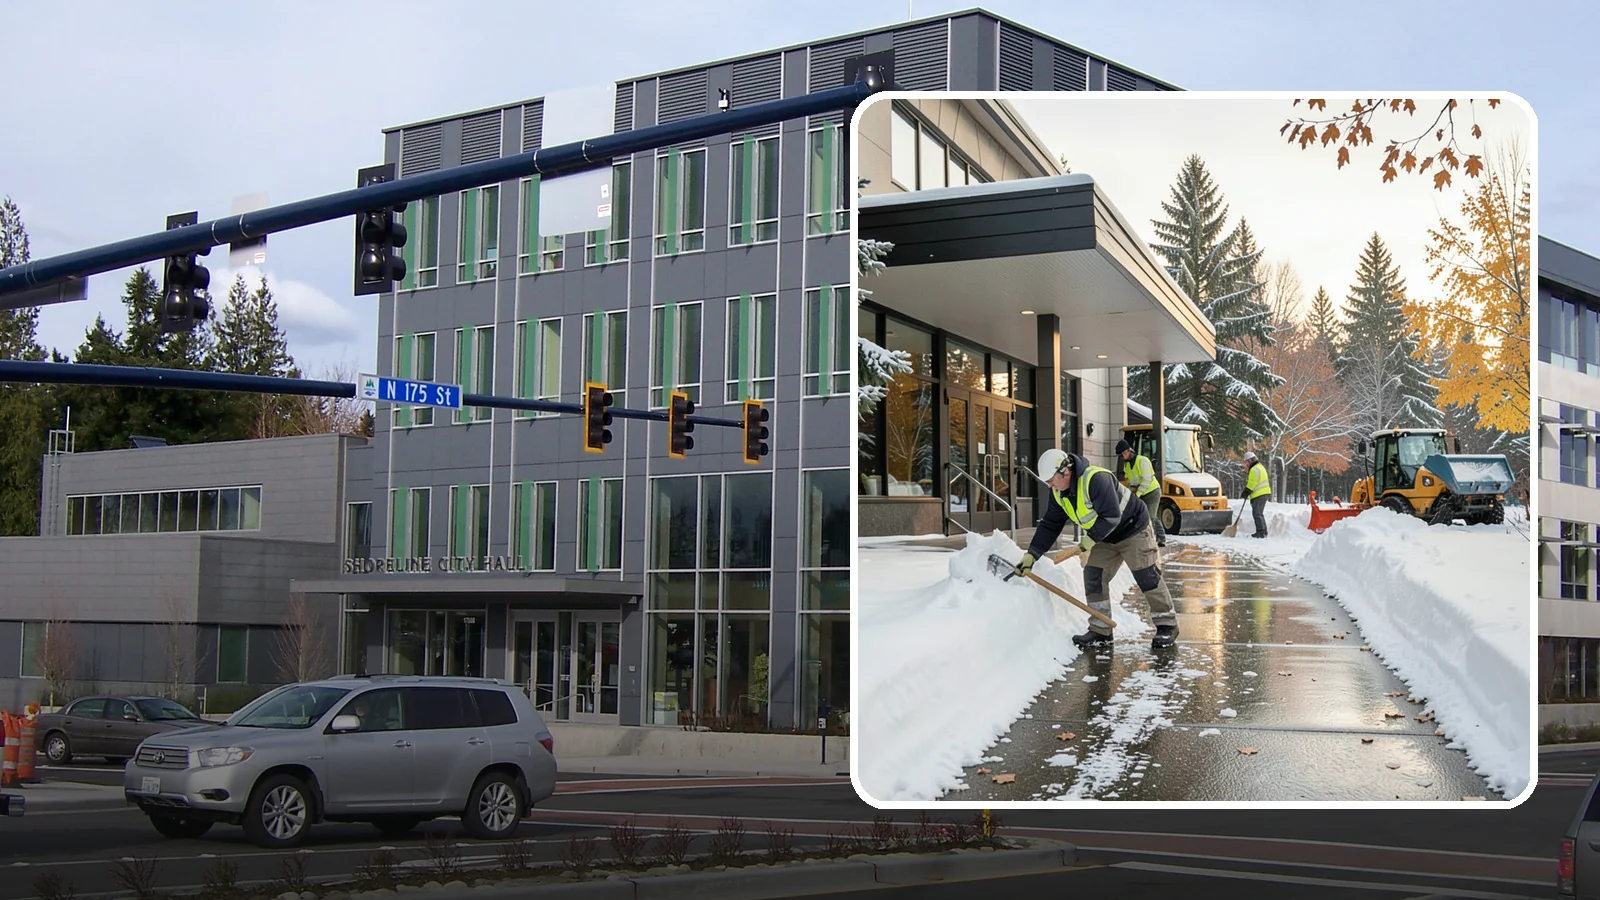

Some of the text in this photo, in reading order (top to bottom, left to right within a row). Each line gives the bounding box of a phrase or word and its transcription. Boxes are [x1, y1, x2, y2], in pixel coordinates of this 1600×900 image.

[387, 380, 451, 406] N 175 St
[344, 555, 526, 574] SHORELINE CITY HALL
